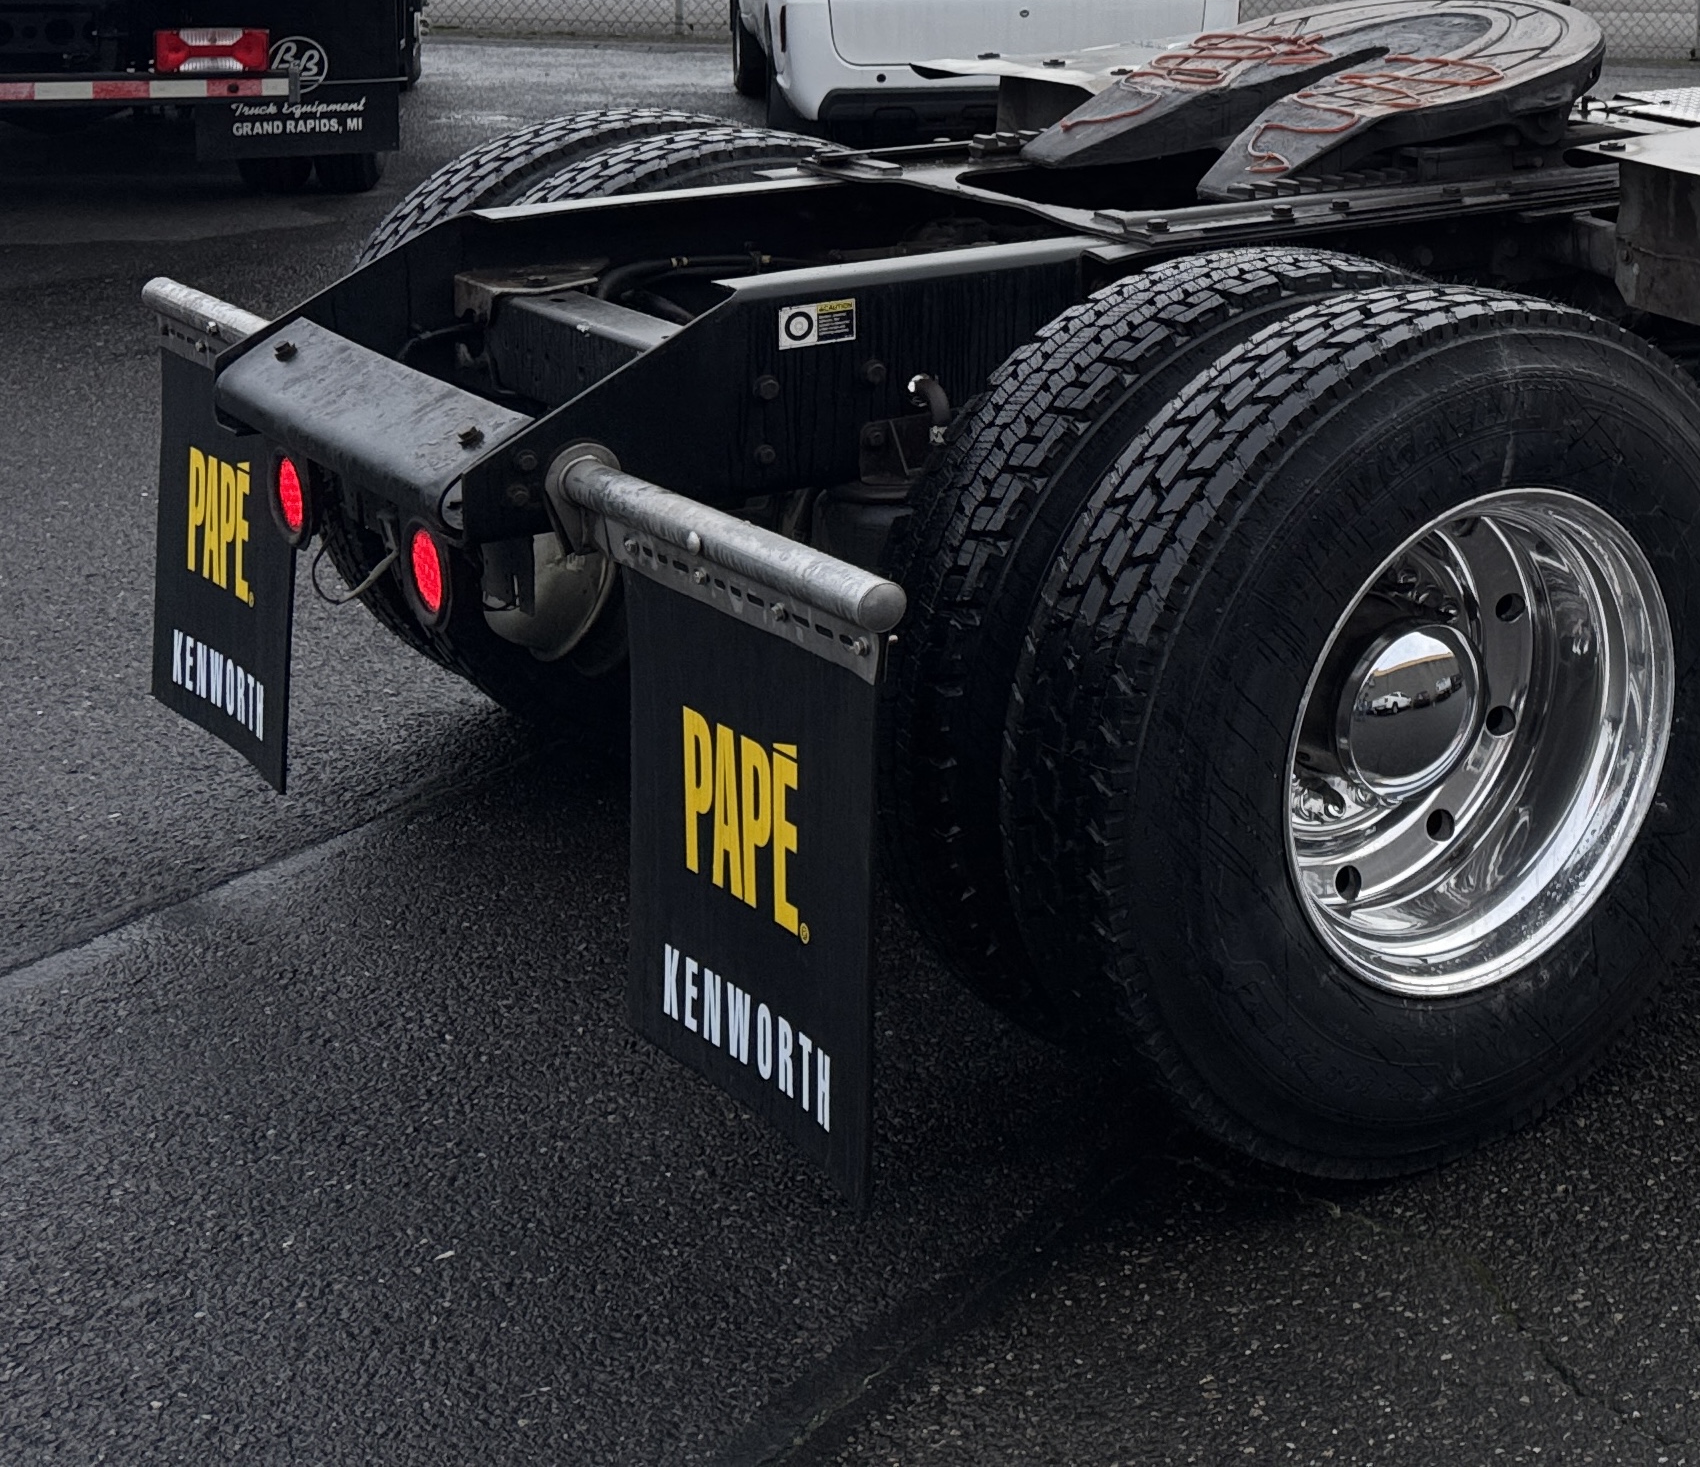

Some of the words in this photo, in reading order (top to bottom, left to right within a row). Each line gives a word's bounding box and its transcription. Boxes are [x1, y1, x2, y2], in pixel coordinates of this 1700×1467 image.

[231, 102, 278, 116] Truck
[282, 96, 366, 118] Equipment
[232, 121, 283, 136] GRAND
[286, 118, 343, 134] RAPIDS,
[346, 117, 363, 131] MI
[187, 446, 250, 603] PAPÉ
[172, 629, 264, 742] KENWORTH
[683, 705, 798, 936] PAPÉ
[664, 943, 830, 1133] KENWORTH
